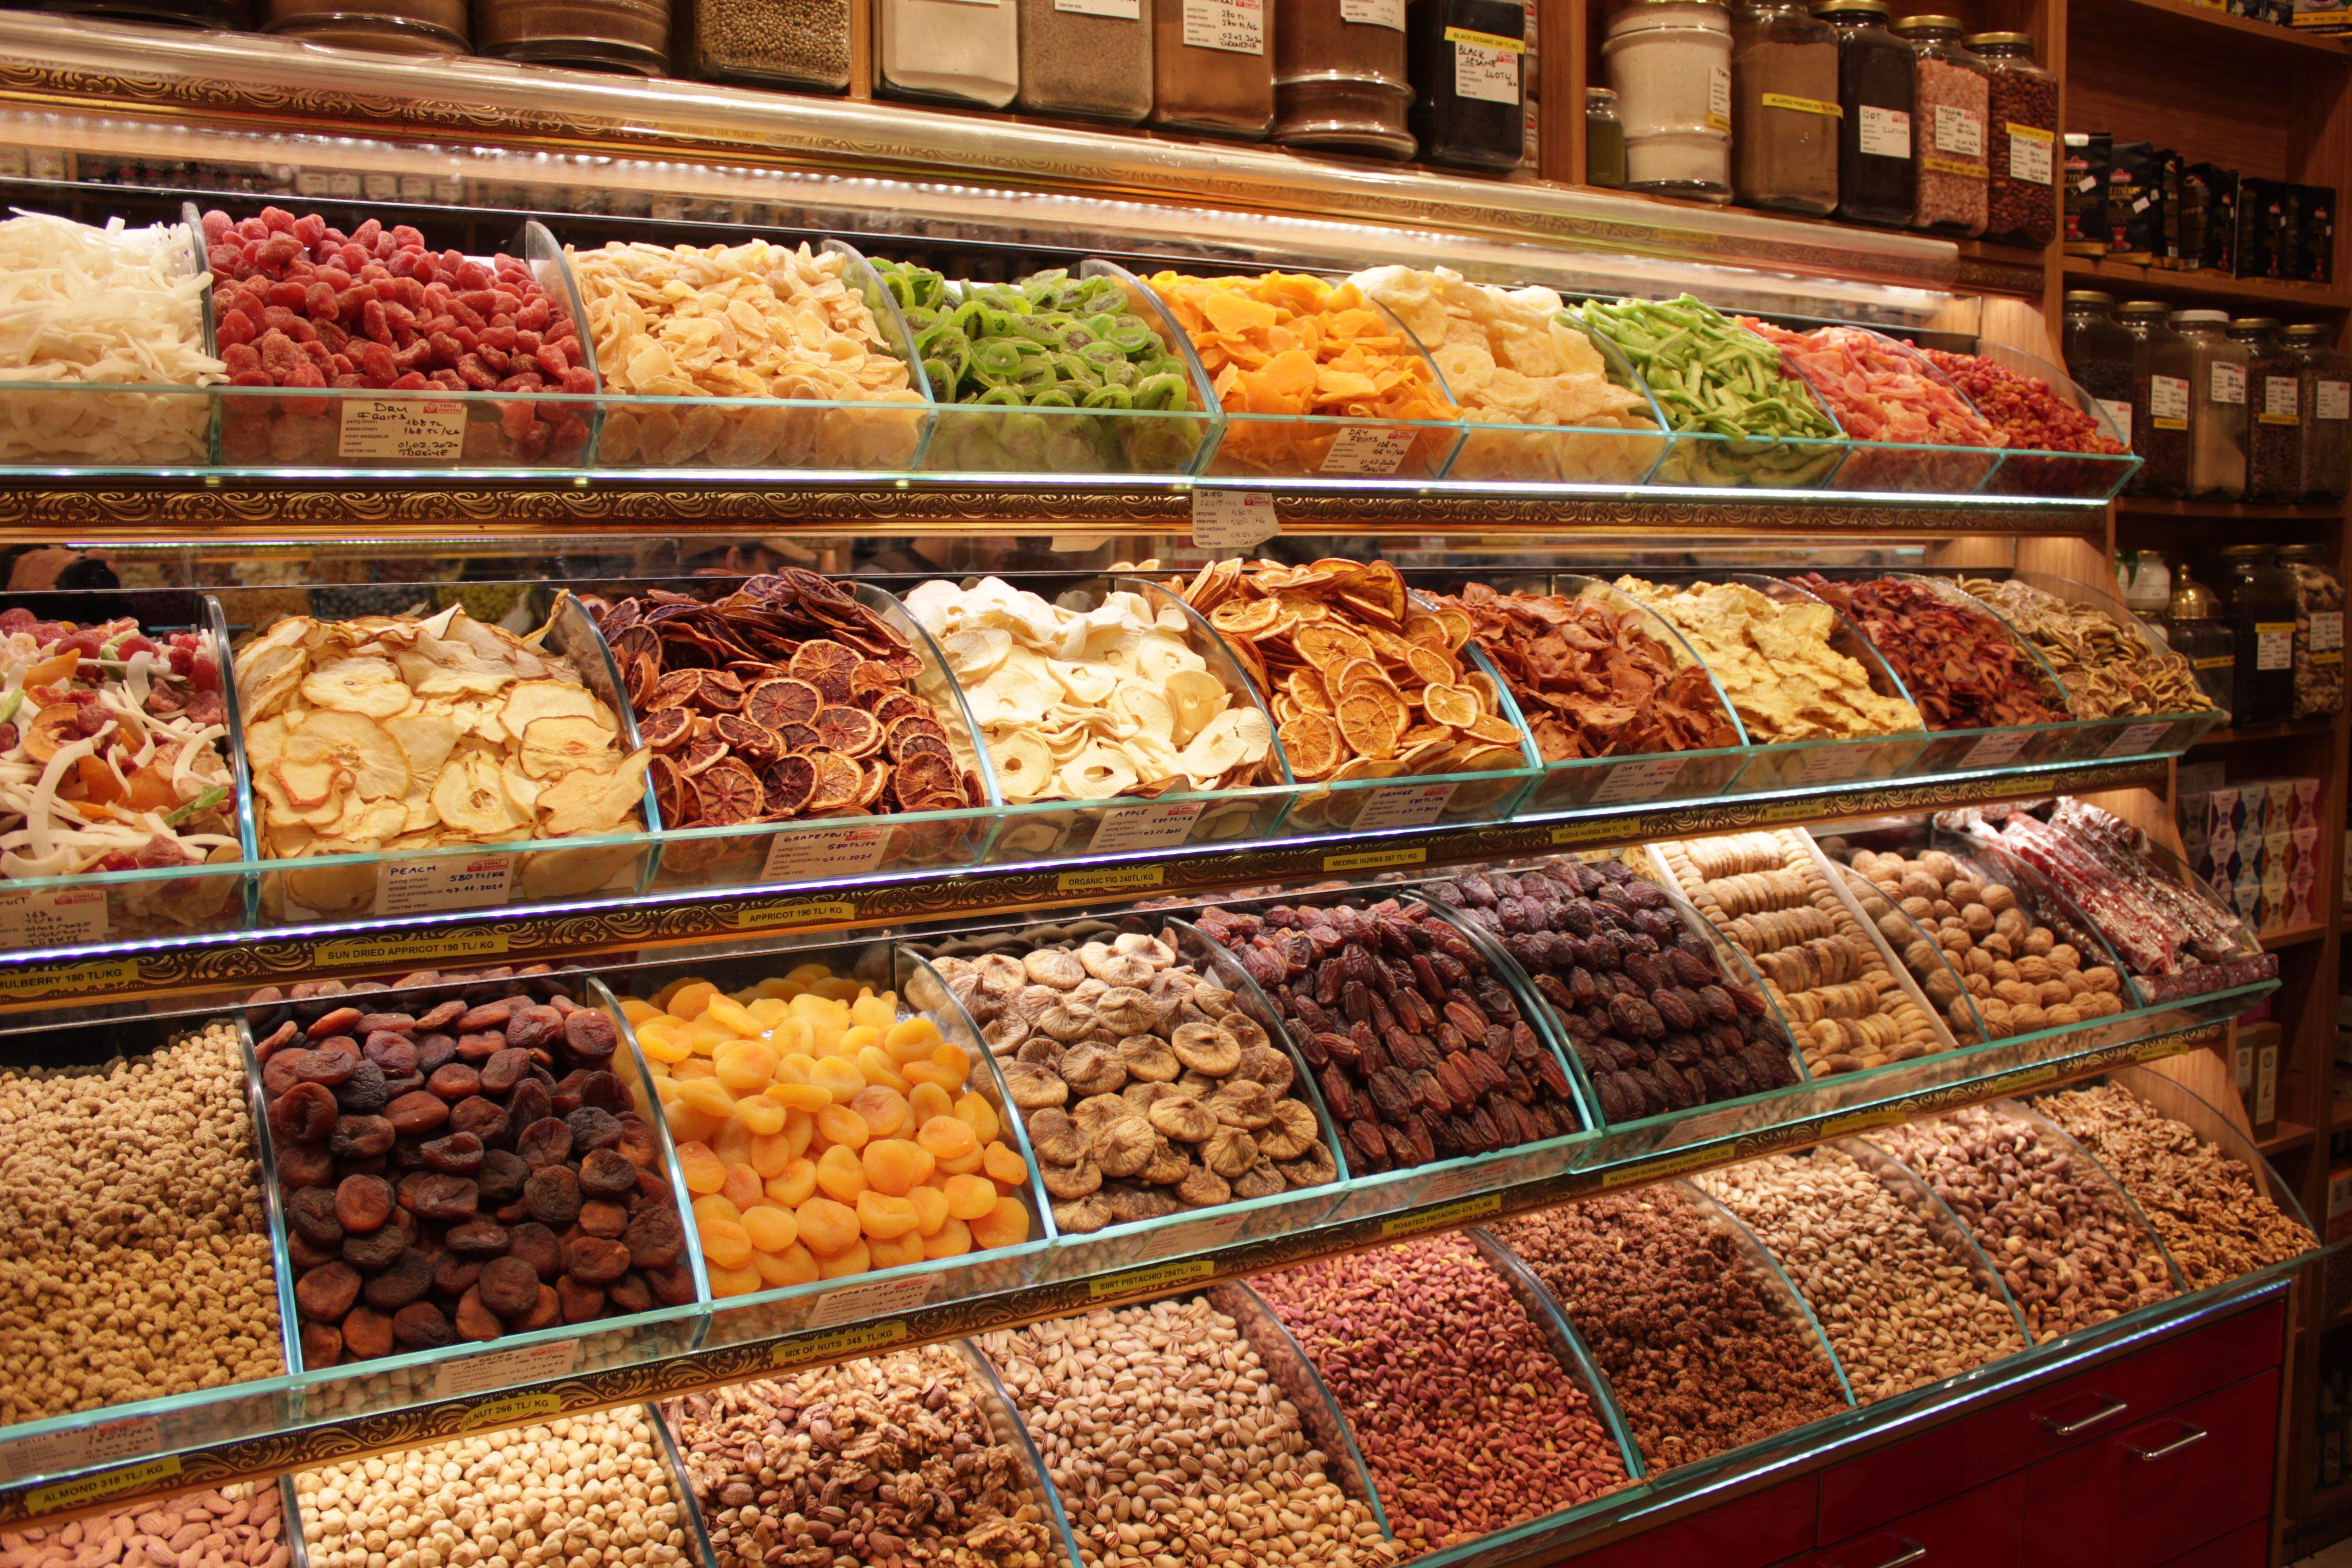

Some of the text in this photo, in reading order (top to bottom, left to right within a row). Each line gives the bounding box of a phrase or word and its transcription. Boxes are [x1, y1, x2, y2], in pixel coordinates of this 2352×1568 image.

[1473, 35, 1493, 44] SESAME
[1459, 44, 1485, 59] BLACK
[1465, 57, 1497, 67] SESAME
[1114, 809, 1149, 818] APPLE
[1333, 858, 1358, 867] MEDINE
[1360, 856, 1383, 865] HURMA
[390, 865, 436, 876] PEACH
[449, 873, 473, 882] 580
[1068, 877, 1103, 886] ORGANIC
[1120, 874, 1154, 882] 240TL/KG
[750, 911, 794, 922] APPRICOT
[328, 940, 494, 960] SUN DRIED APPRICOT 190 TL/ KG
[66, 973, 84, 983] 180
[87, 968, 122, 980] TL/KG
[1609, 1156, 1702, 1182] PISTACHIO SUSSAME WITH HONEY
[1393, 1216, 1425, 1230] ROASTED
[1426, 1208, 1461, 1222] PISTACHIO
[1100, 1279, 1120, 1290] SIIRT
[1122, 1272, 1162, 1286] PISTACHIO
[785, 1348, 800, 1358] MIX
[802, 1346, 815, 1354] OF
[818, 1340, 842, 1351] NUTS
[867, 1330, 893, 1342] TL/KG
[496, 1399, 549, 1414] 266 TL/ KG
[44, 1482, 98, 1504] ALMOND
[147, 1465, 164, 1475] KG
